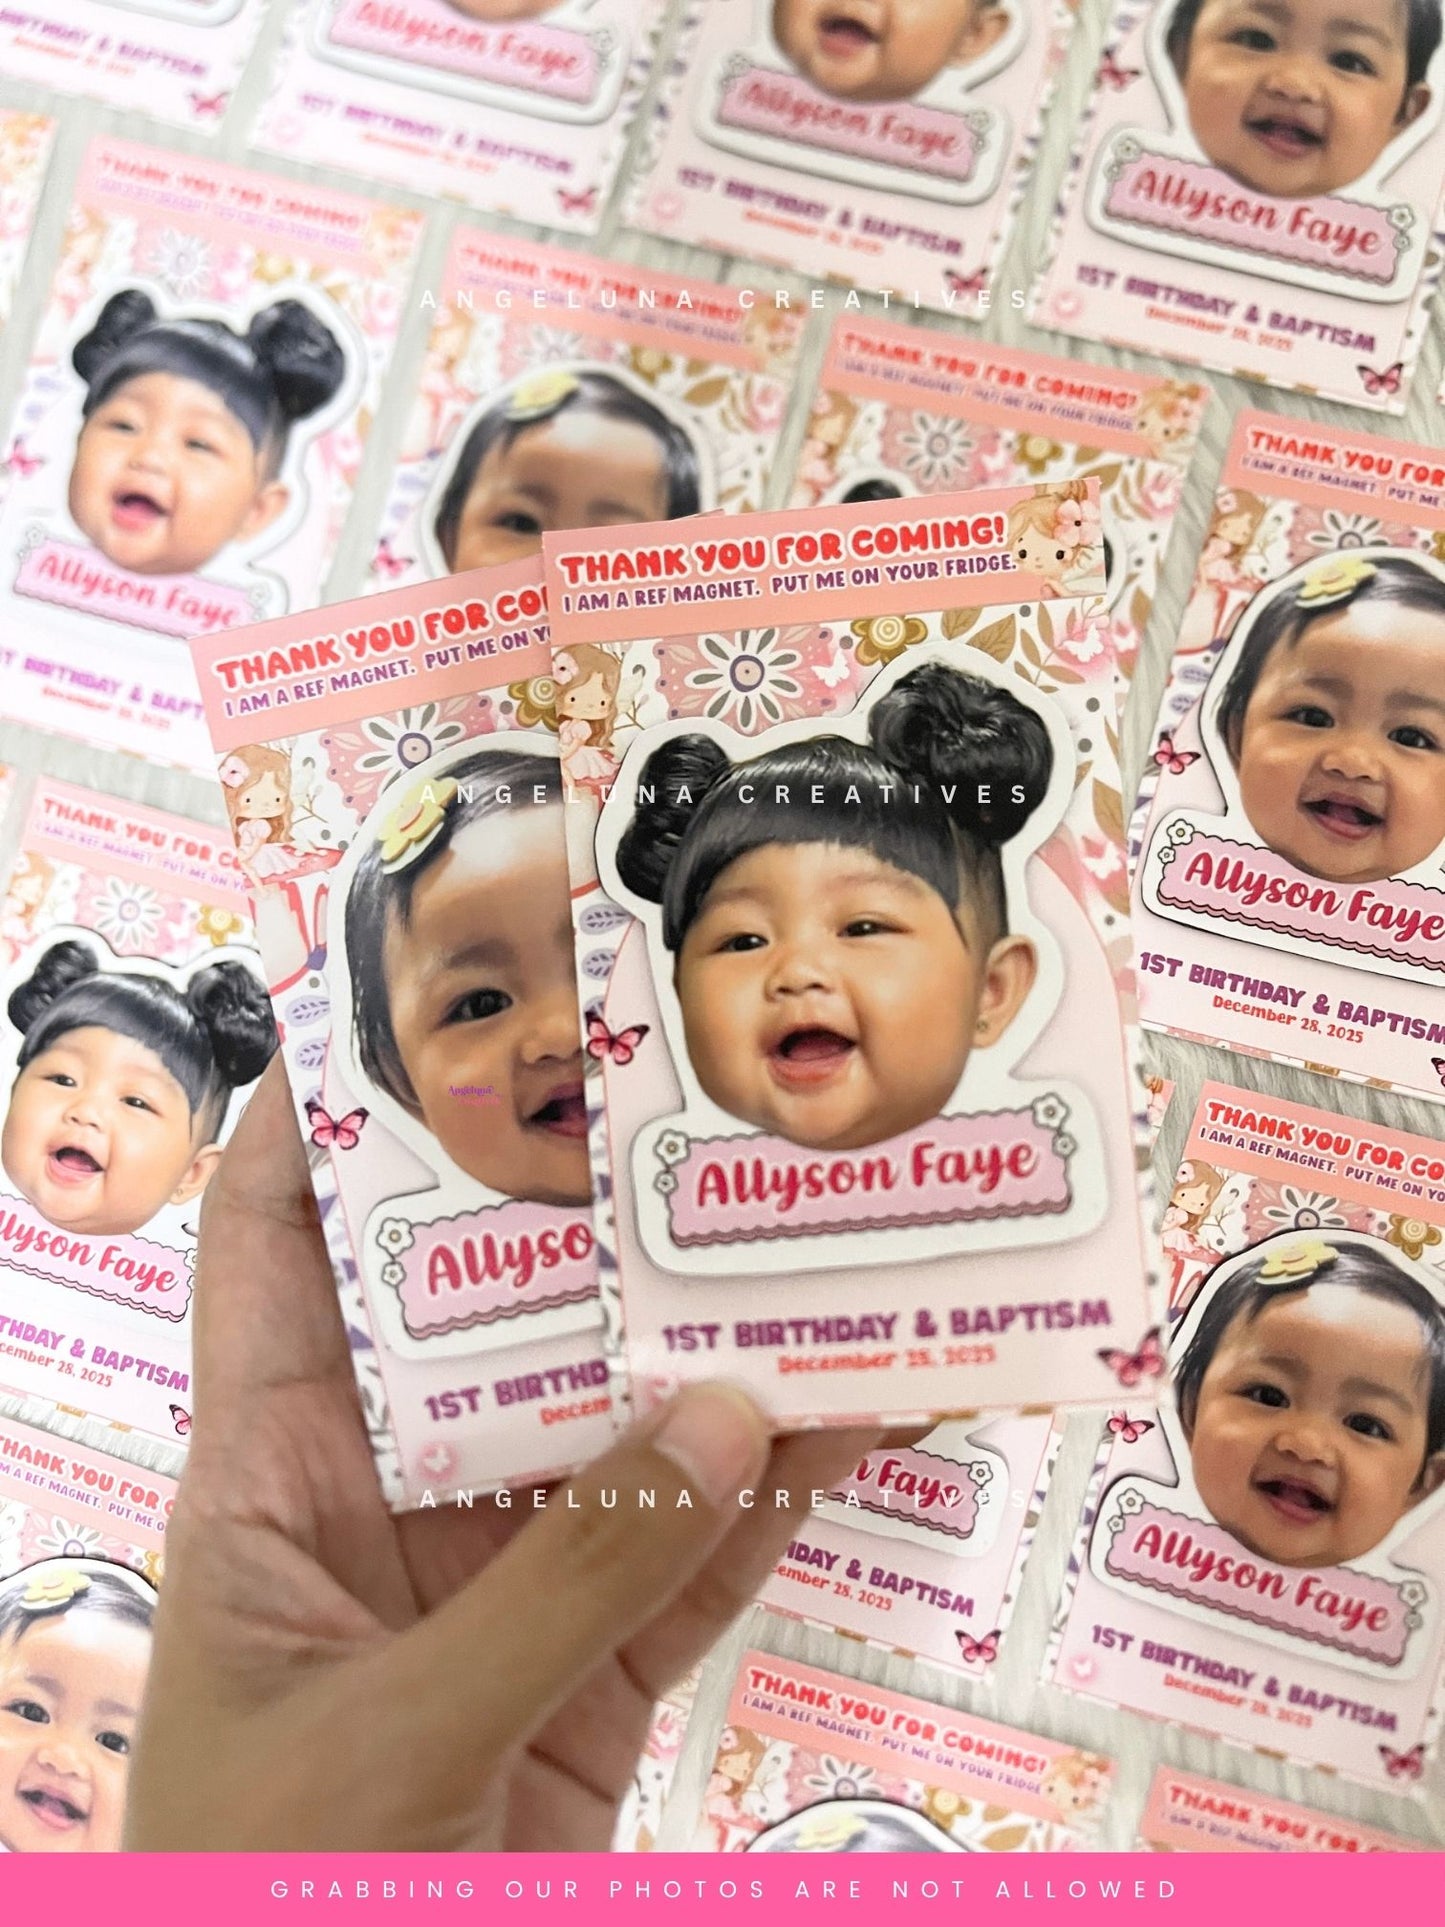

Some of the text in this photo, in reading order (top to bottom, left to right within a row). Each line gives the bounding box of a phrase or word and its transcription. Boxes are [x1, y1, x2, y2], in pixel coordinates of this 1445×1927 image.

[1131, 169, 1384, 255] Allyson Faye
[1251, 430, 1445, 487] THANK YOU FOR
[561, 516, 1006, 584] THANK YOU FOR COMING!
[564, 554, 1016, 612] I AM A REF MAGNET. PUT ME ON YOUR FRIDGE.
[38, 554, 237, 630] Allyson Faye
[217, 638, 341, 688] THANK
[346, 620, 415, 658] YOU
[425, 602, 488, 641] FOR
[226, 702, 233, 717] I
[240, 693, 270, 714] AM
[277, 689, 289, 704] A
[295, 680, 325, 700] REF
[331, 660, 416, 692] MAGNET.
[425, 646, 461, 669] PUT
[468, 638, 497, 659] ME
[501, 630, 529, 650] ON
[44, 798, 212, 862] THANK YOU FOR
[1184, 852, 1445, 942] Allyson Faye
[1140, 952, 1445, 1046] 1ST BIRTHDAY & BAPTISM
[1212, 995, 1364, 1044] December 28, 2025
[1199, 1127, 1206, 1138] I
[1209, 1131, 1232, 1145] AM
[1236, 1136, 1245, 1148] A
[1249, 1140, 1273, 1155] REF
[1276, 1147, 1336, 1173] MAGNET.
[1346, 1166, 1373, 1182] PUT
[1377, 1174, 1398, 1189] ME
[1402, 1182, 1423, 1196] ON
[1208, 1102, 1295, 1141] THANK
[1302, 1127, 1351, 1156] YOU
[1357, 1142, 1405, 1171] FOR
[697, 1140, 1037, 1212] Allyson Faye
[98, 1245, 178, 1292] Faye
[427, 1222, 595, 1296] Allyso
[662, 1299, 1112, 1351] 1ST BIRTHDAY & BAPTISM
[58, 1360, 75, 1377] 28,
[81, 1368, 113, 1388] 2025
[70, 1338, 85, 1358] &
[92, 1345, 190, 1392] BAPTISM
[424, 1386, 481, 1421] 1ST
[14, 1468, 21, 1479] A
[25, 1472, 46, 1488] REF
[109, 1502, 133, 1520] PUT
[135, 1513, 152, 1528] ME
[72, 1462, 114, 1491] YOU
[119, 1481, 159, 1509] FOR
[846, 1559, 862, 1580] &
[869, 1566, 974, 1617] BAPTISM
[858, 1590, 893, 1611] 2025
[1134, 1524, 1389, 1632] Allyson Faye
[1093, 1624, 1397, 1732] 1ST BIRTHDAY & BAPTISM
[751, 1669, 1047, 1775] THANK YOU FOR COMING!
[752, 1695, 773, 1712] AM
[777, 1705, 786, 1716] A
[790, 1709, 812, 1722] REF
[882, 1737, 907, 1752] PUT
[912, 1745, 930, 1760] ME
[936, 1753, 954, 1767] ON
[960, 1761, 993, 1779] YOUR
[1262, 1813, 1307, 1840] YOU
